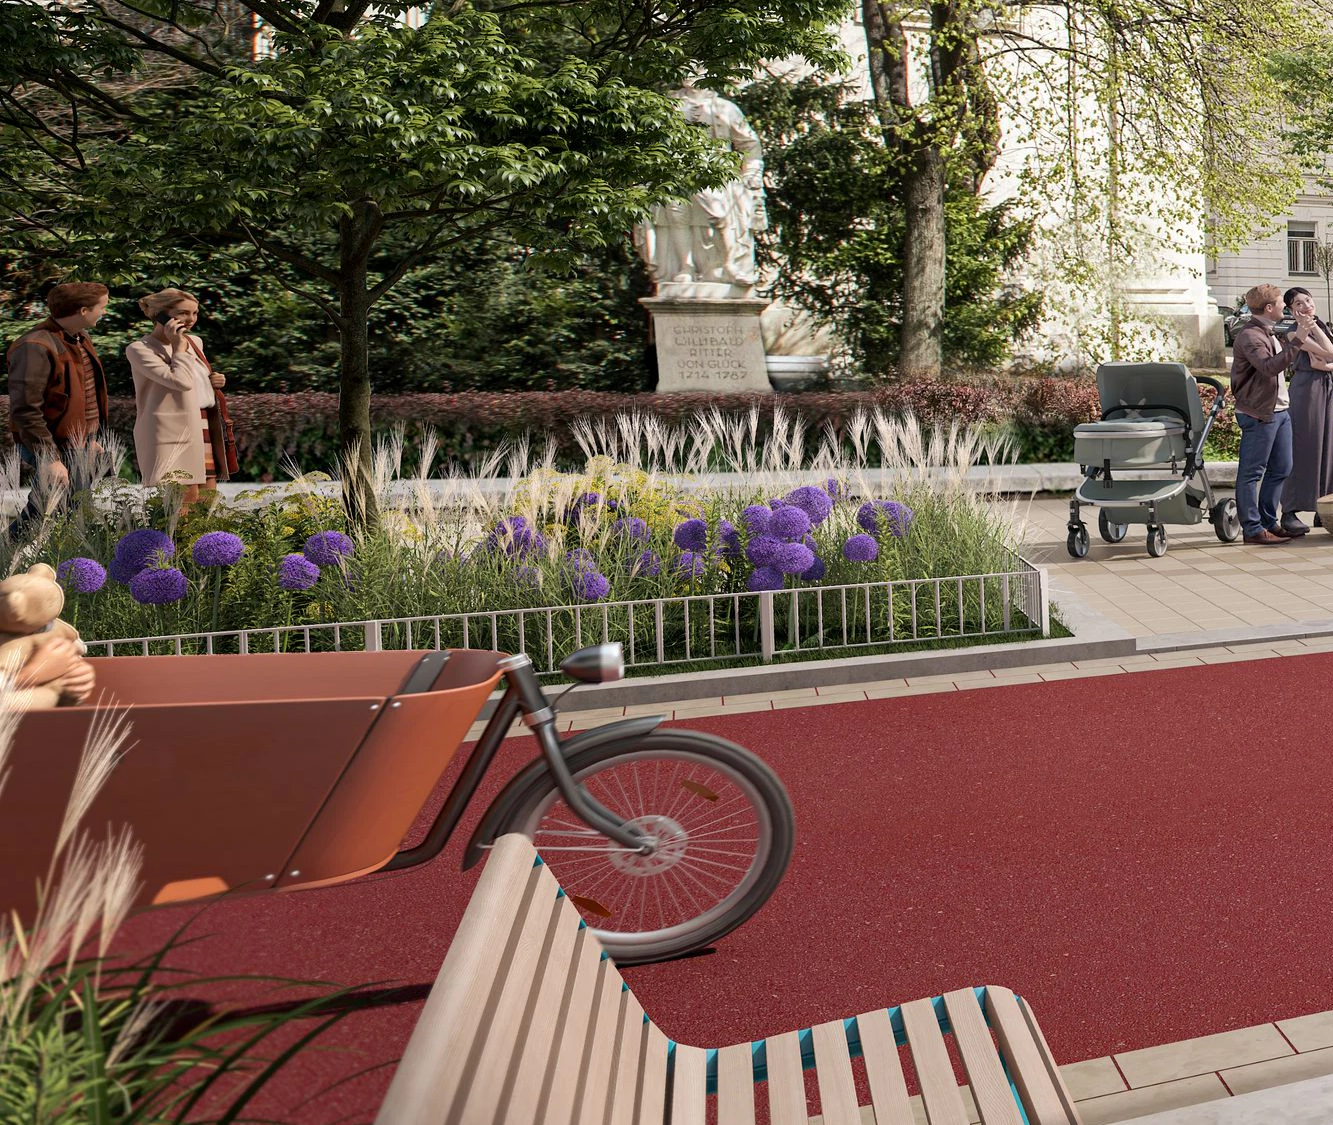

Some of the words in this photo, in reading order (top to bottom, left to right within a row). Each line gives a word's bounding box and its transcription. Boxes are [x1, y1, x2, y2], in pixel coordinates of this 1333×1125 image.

[673, 325, 743, 335] CHRISTOPH
[689, 347, 734, 357] RITTER
[678, 370, 710, 380] 1714
[714, 370, 748, 380] 1787
